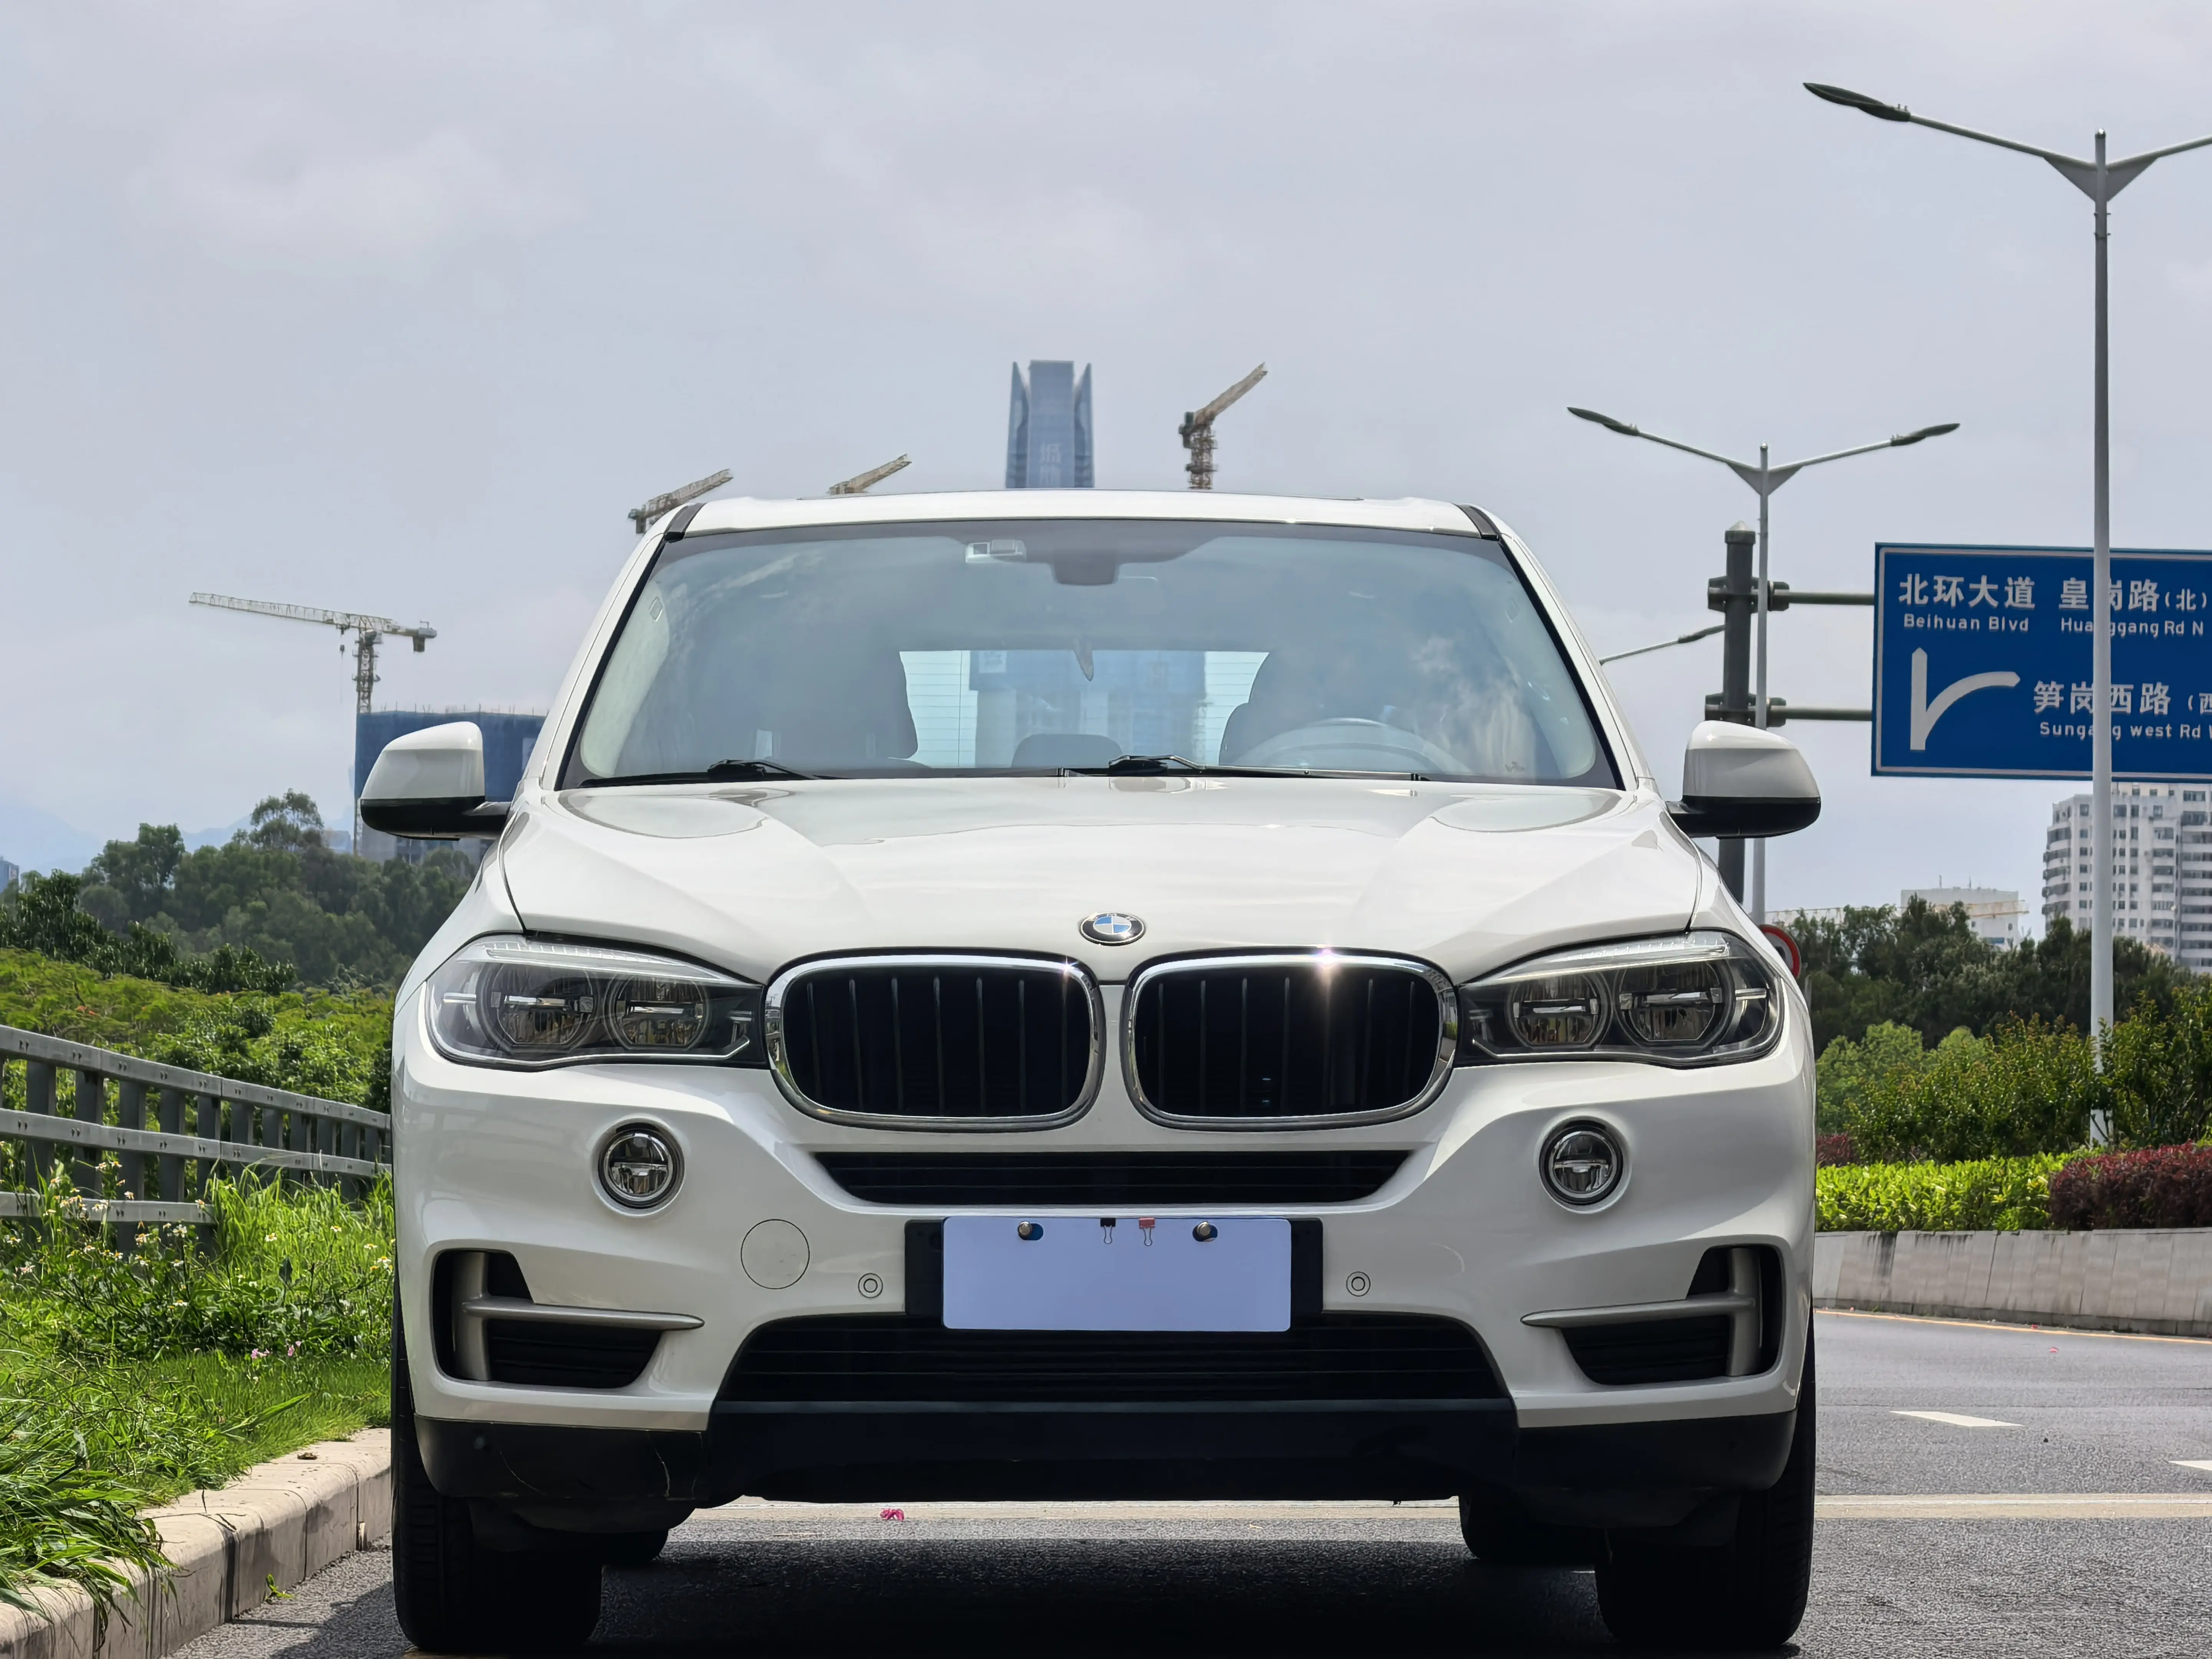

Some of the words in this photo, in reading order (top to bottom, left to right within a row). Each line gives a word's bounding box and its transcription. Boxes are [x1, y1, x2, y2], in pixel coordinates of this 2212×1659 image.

[1899, 573, 2035, 609] 北环大道
[1904, 613, 1980, 629] Beihuan
[1989, 616, 2028, 632] Blvd
[2061, 617, 2159, 638] Huaggang
[2164, 621, 2184, 636] Rd
[2192, 621, 2203, 636] N
[2040, 722, 2121, 740] Sungag
[2130, 724, 2172, 738] west
[2180, 724, 2200, 738] Rd
